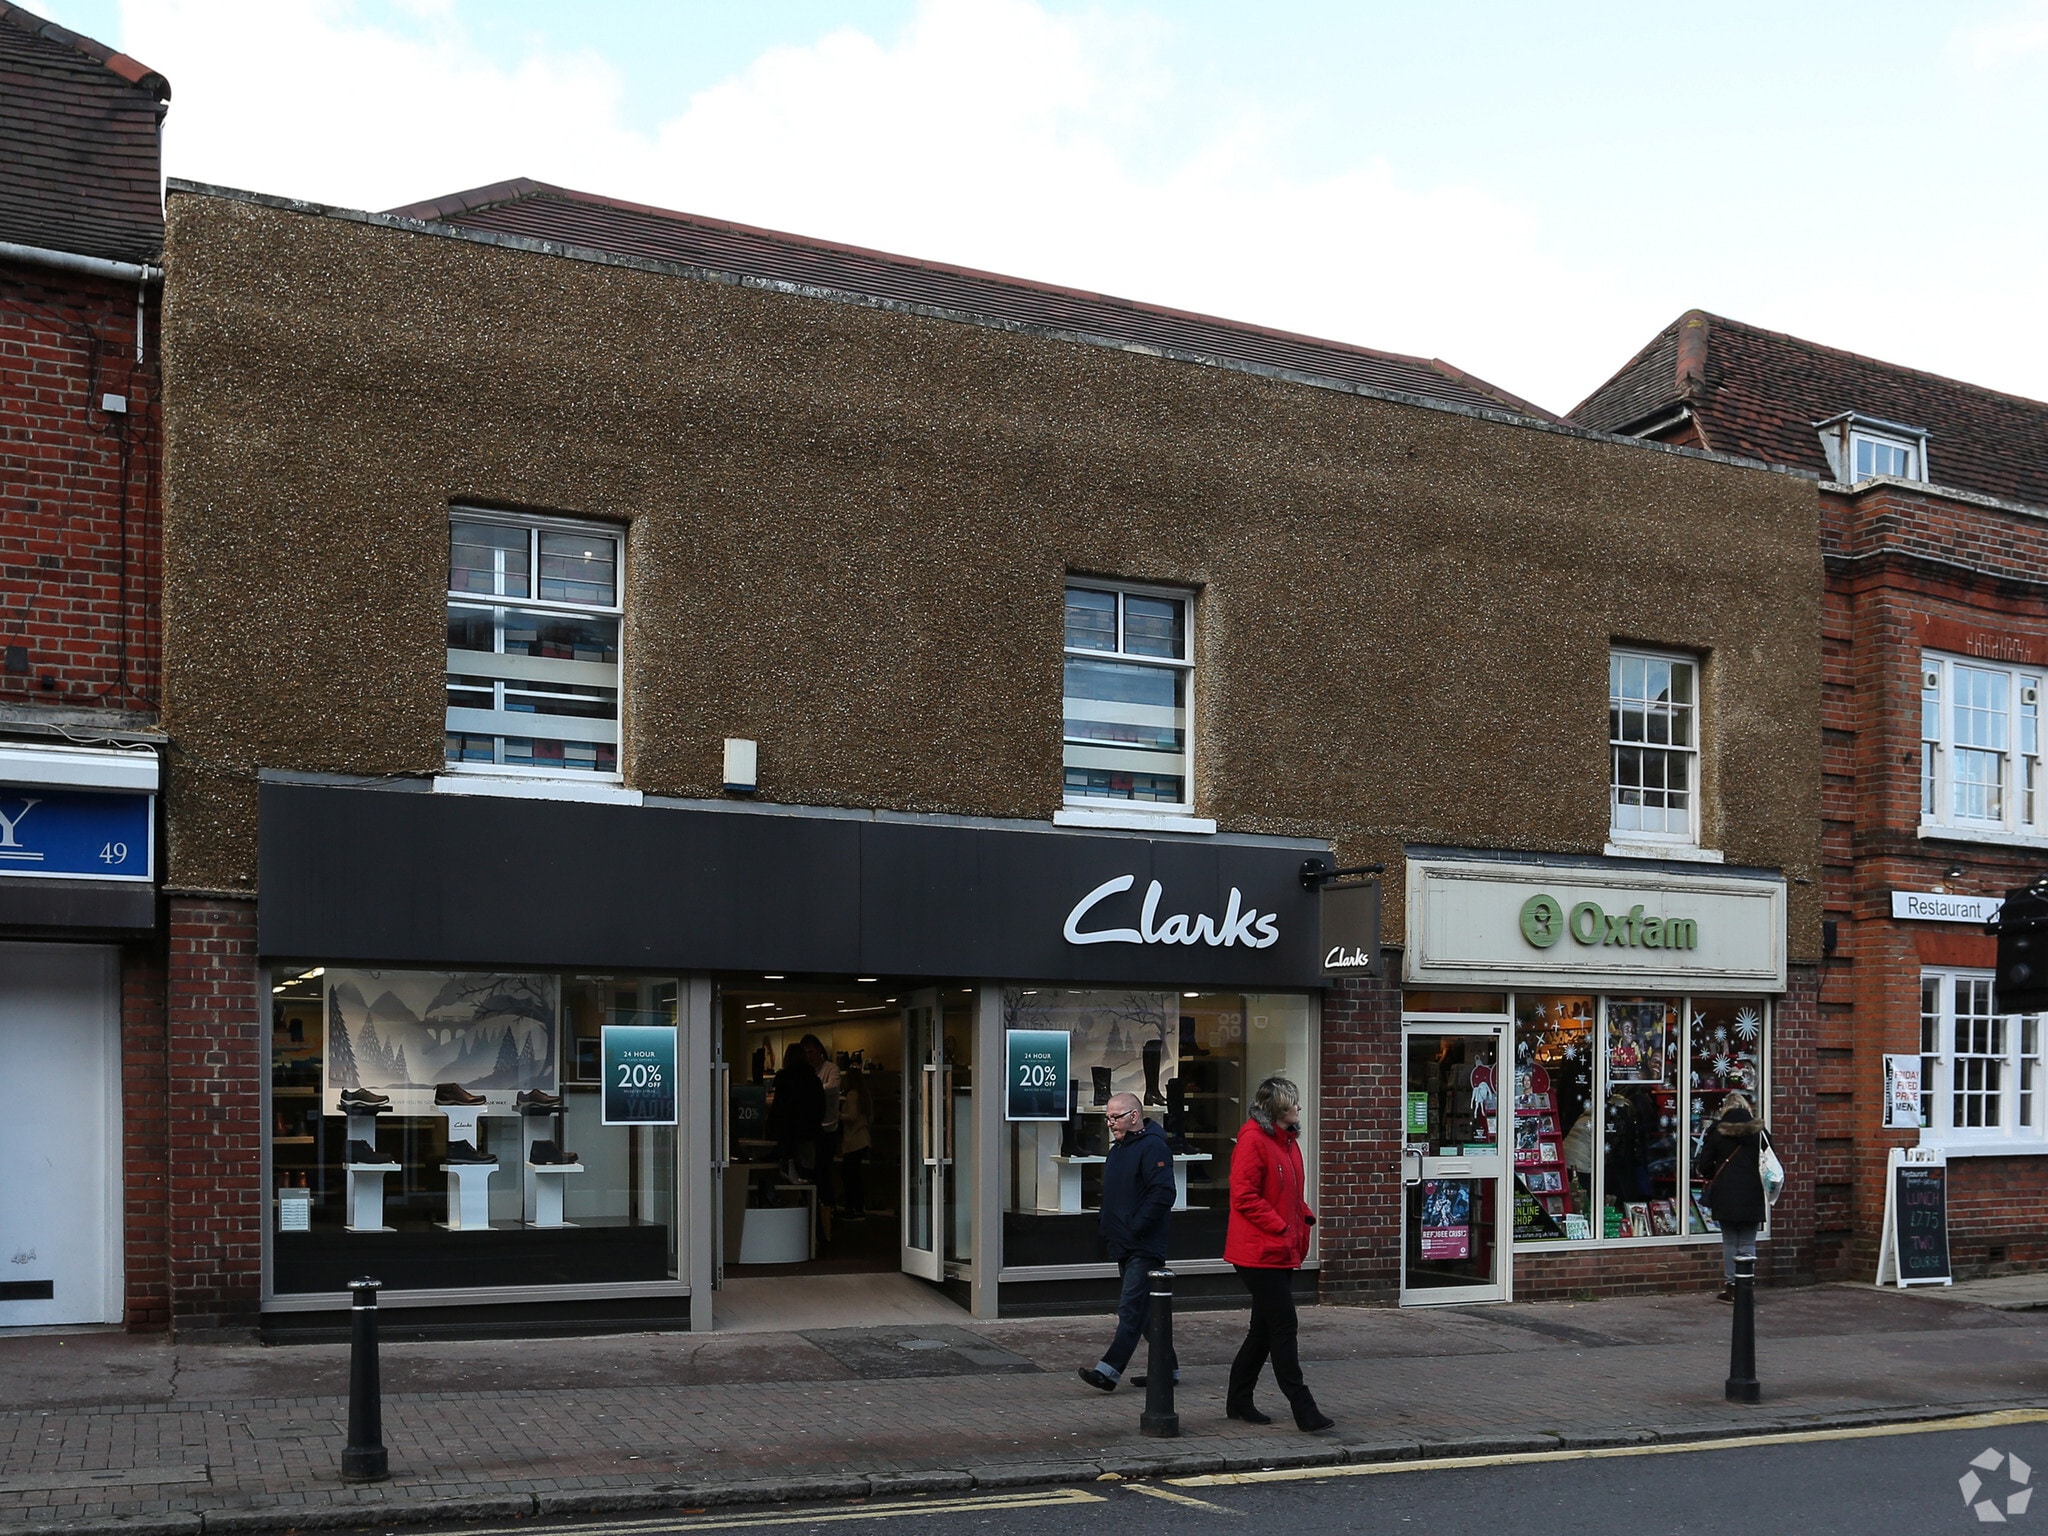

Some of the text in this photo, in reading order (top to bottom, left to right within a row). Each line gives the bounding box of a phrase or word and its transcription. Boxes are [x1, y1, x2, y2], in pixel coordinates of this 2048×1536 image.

[99, 842, 128, 864] 49
[1062, 873, 1280, 950] Clarks
[1908, 896, 1981, 919] Restaurant
[1569, 901, 1698, 949] Oxfam
[1324, 945, 1370, 969] Clarks
[617, 1064, 662, 1088] 20%
[1019, 1064, 1057, 1087] 20%
[1894, 1071, 1919, 1079] FRIDAY
[1905, 1191, 1939, 1206] LUNCH
[1910, 1235, 1935, 1250] TWO
